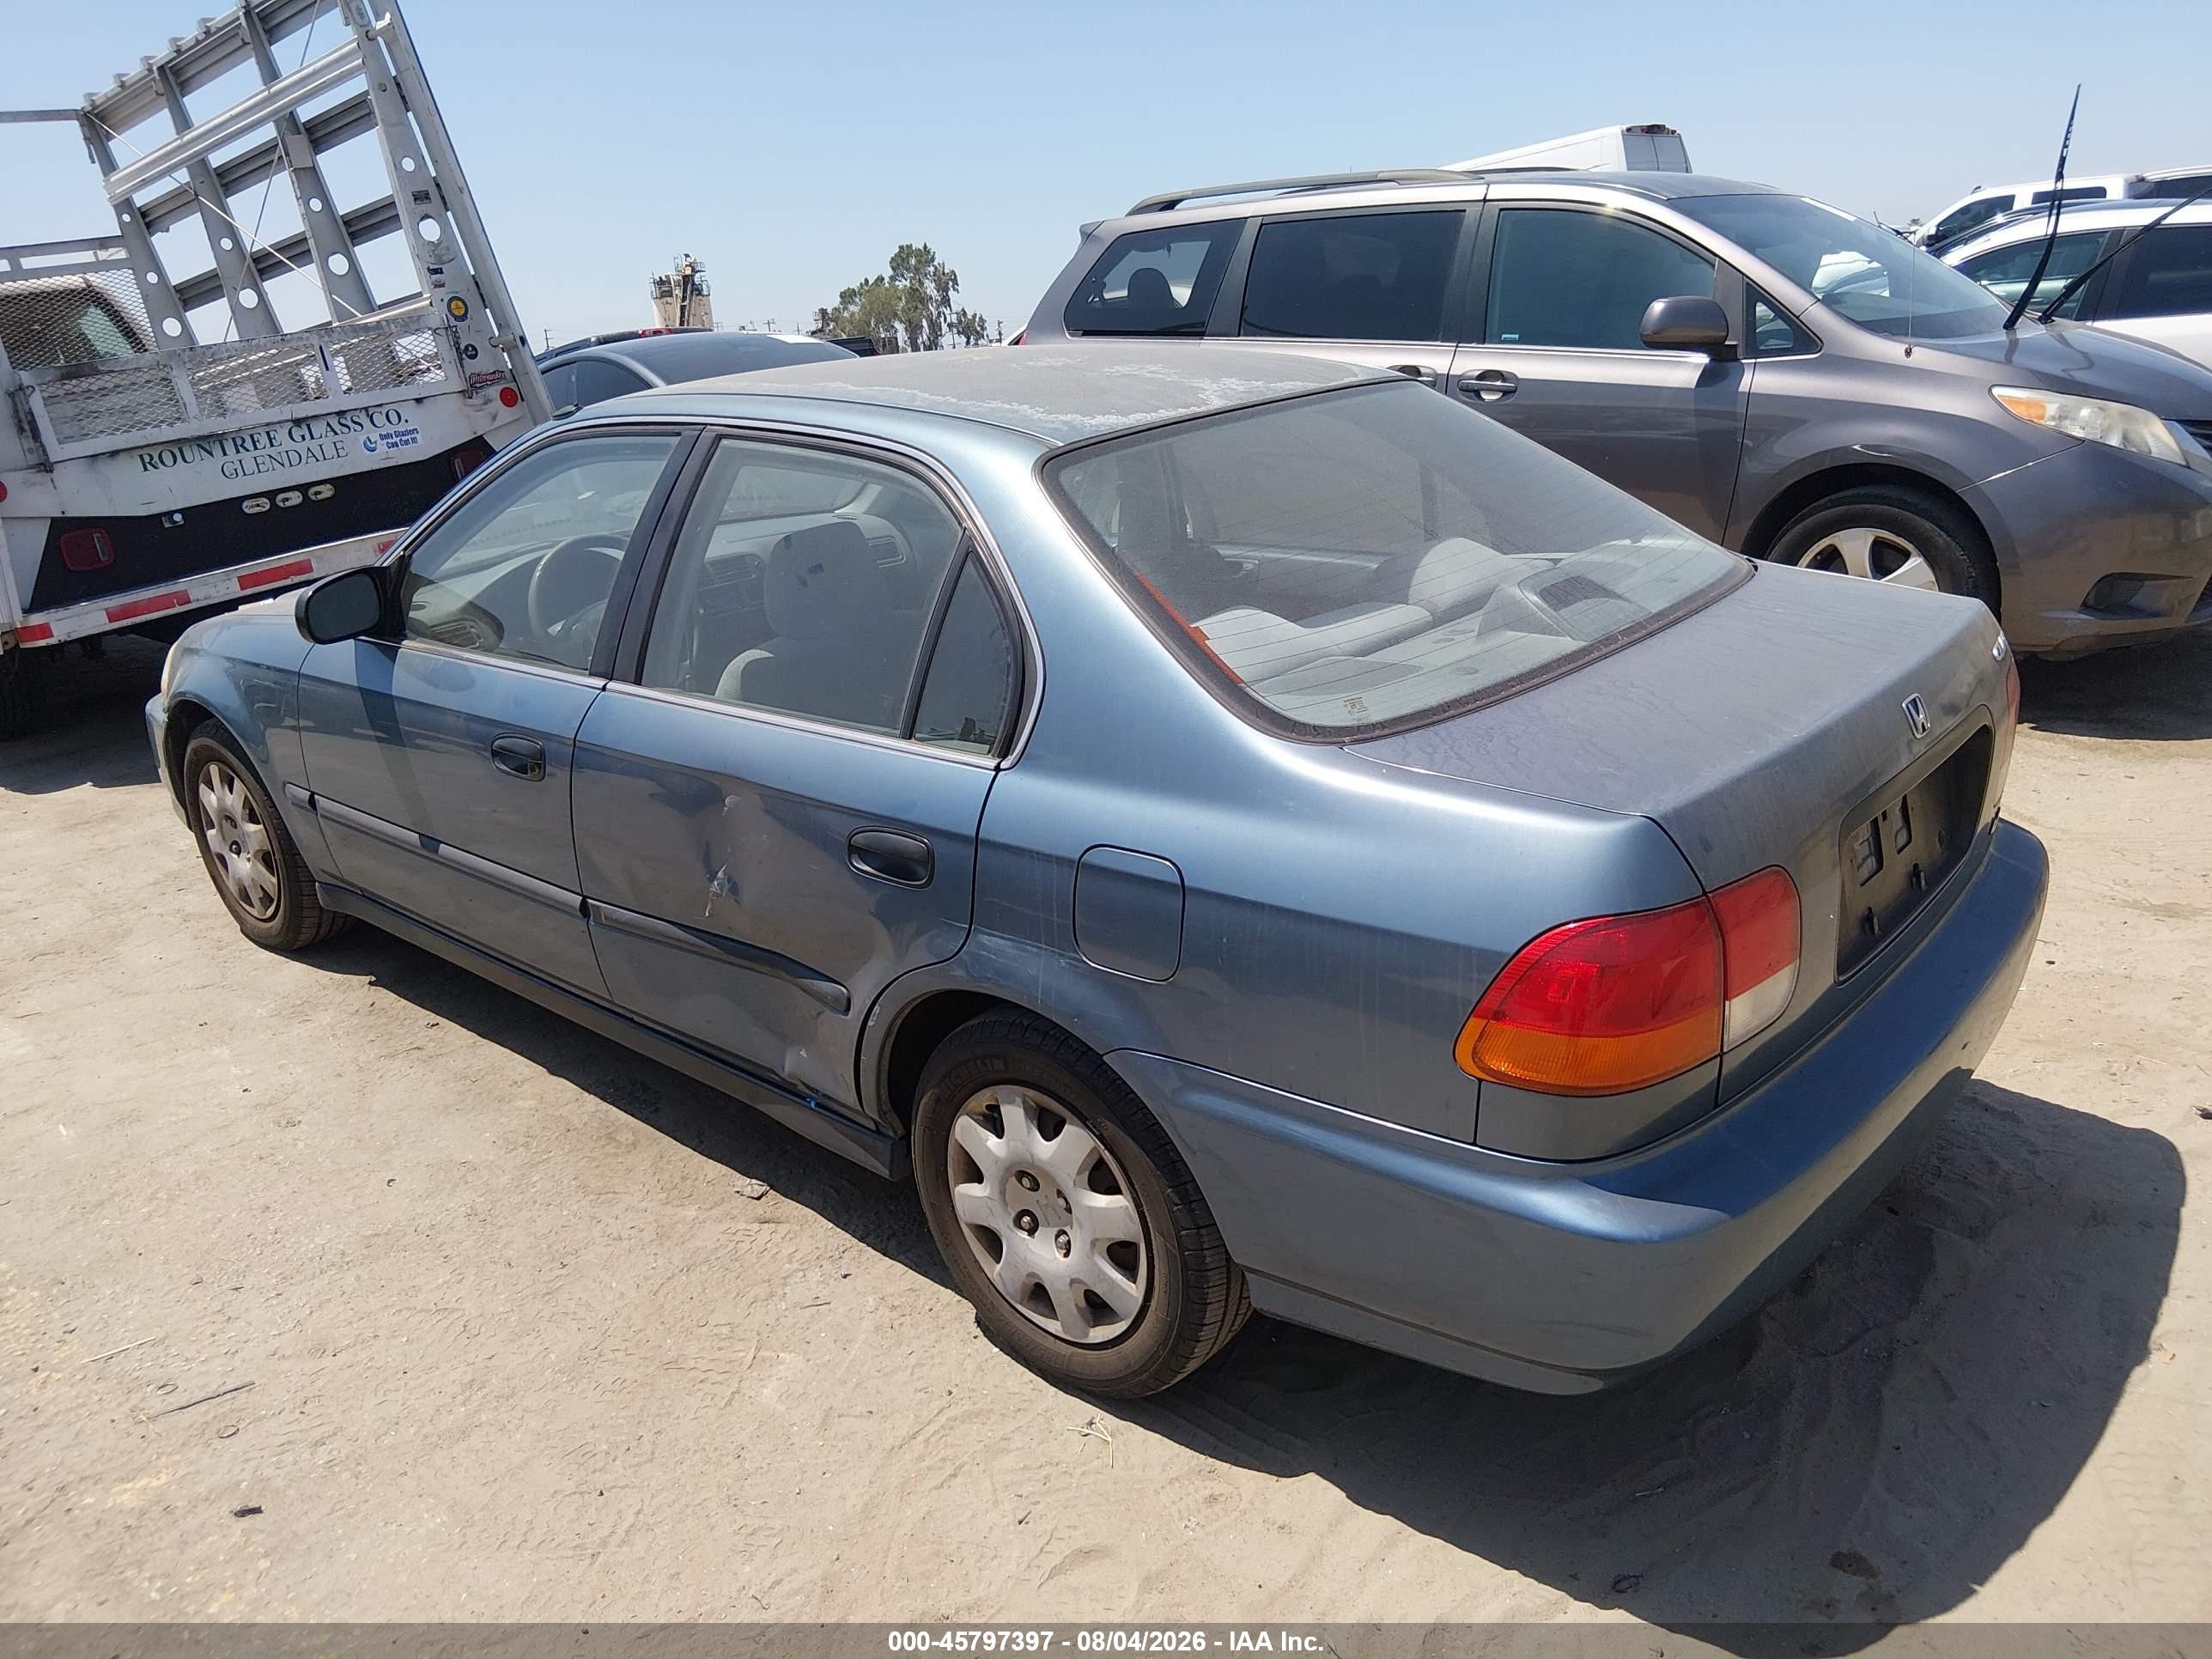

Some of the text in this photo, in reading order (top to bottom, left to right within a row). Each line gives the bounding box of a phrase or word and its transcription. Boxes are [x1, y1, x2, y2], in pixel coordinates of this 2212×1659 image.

[137, 409, 409, 472] ROUNTREE GLASS CO.
[379, 428, 420, 441] Only Glaziers
[386, 441, 399, 450] Can
[398, 437, 411, 447] Cut
[221, 440, 349, 480] GLENDALE
